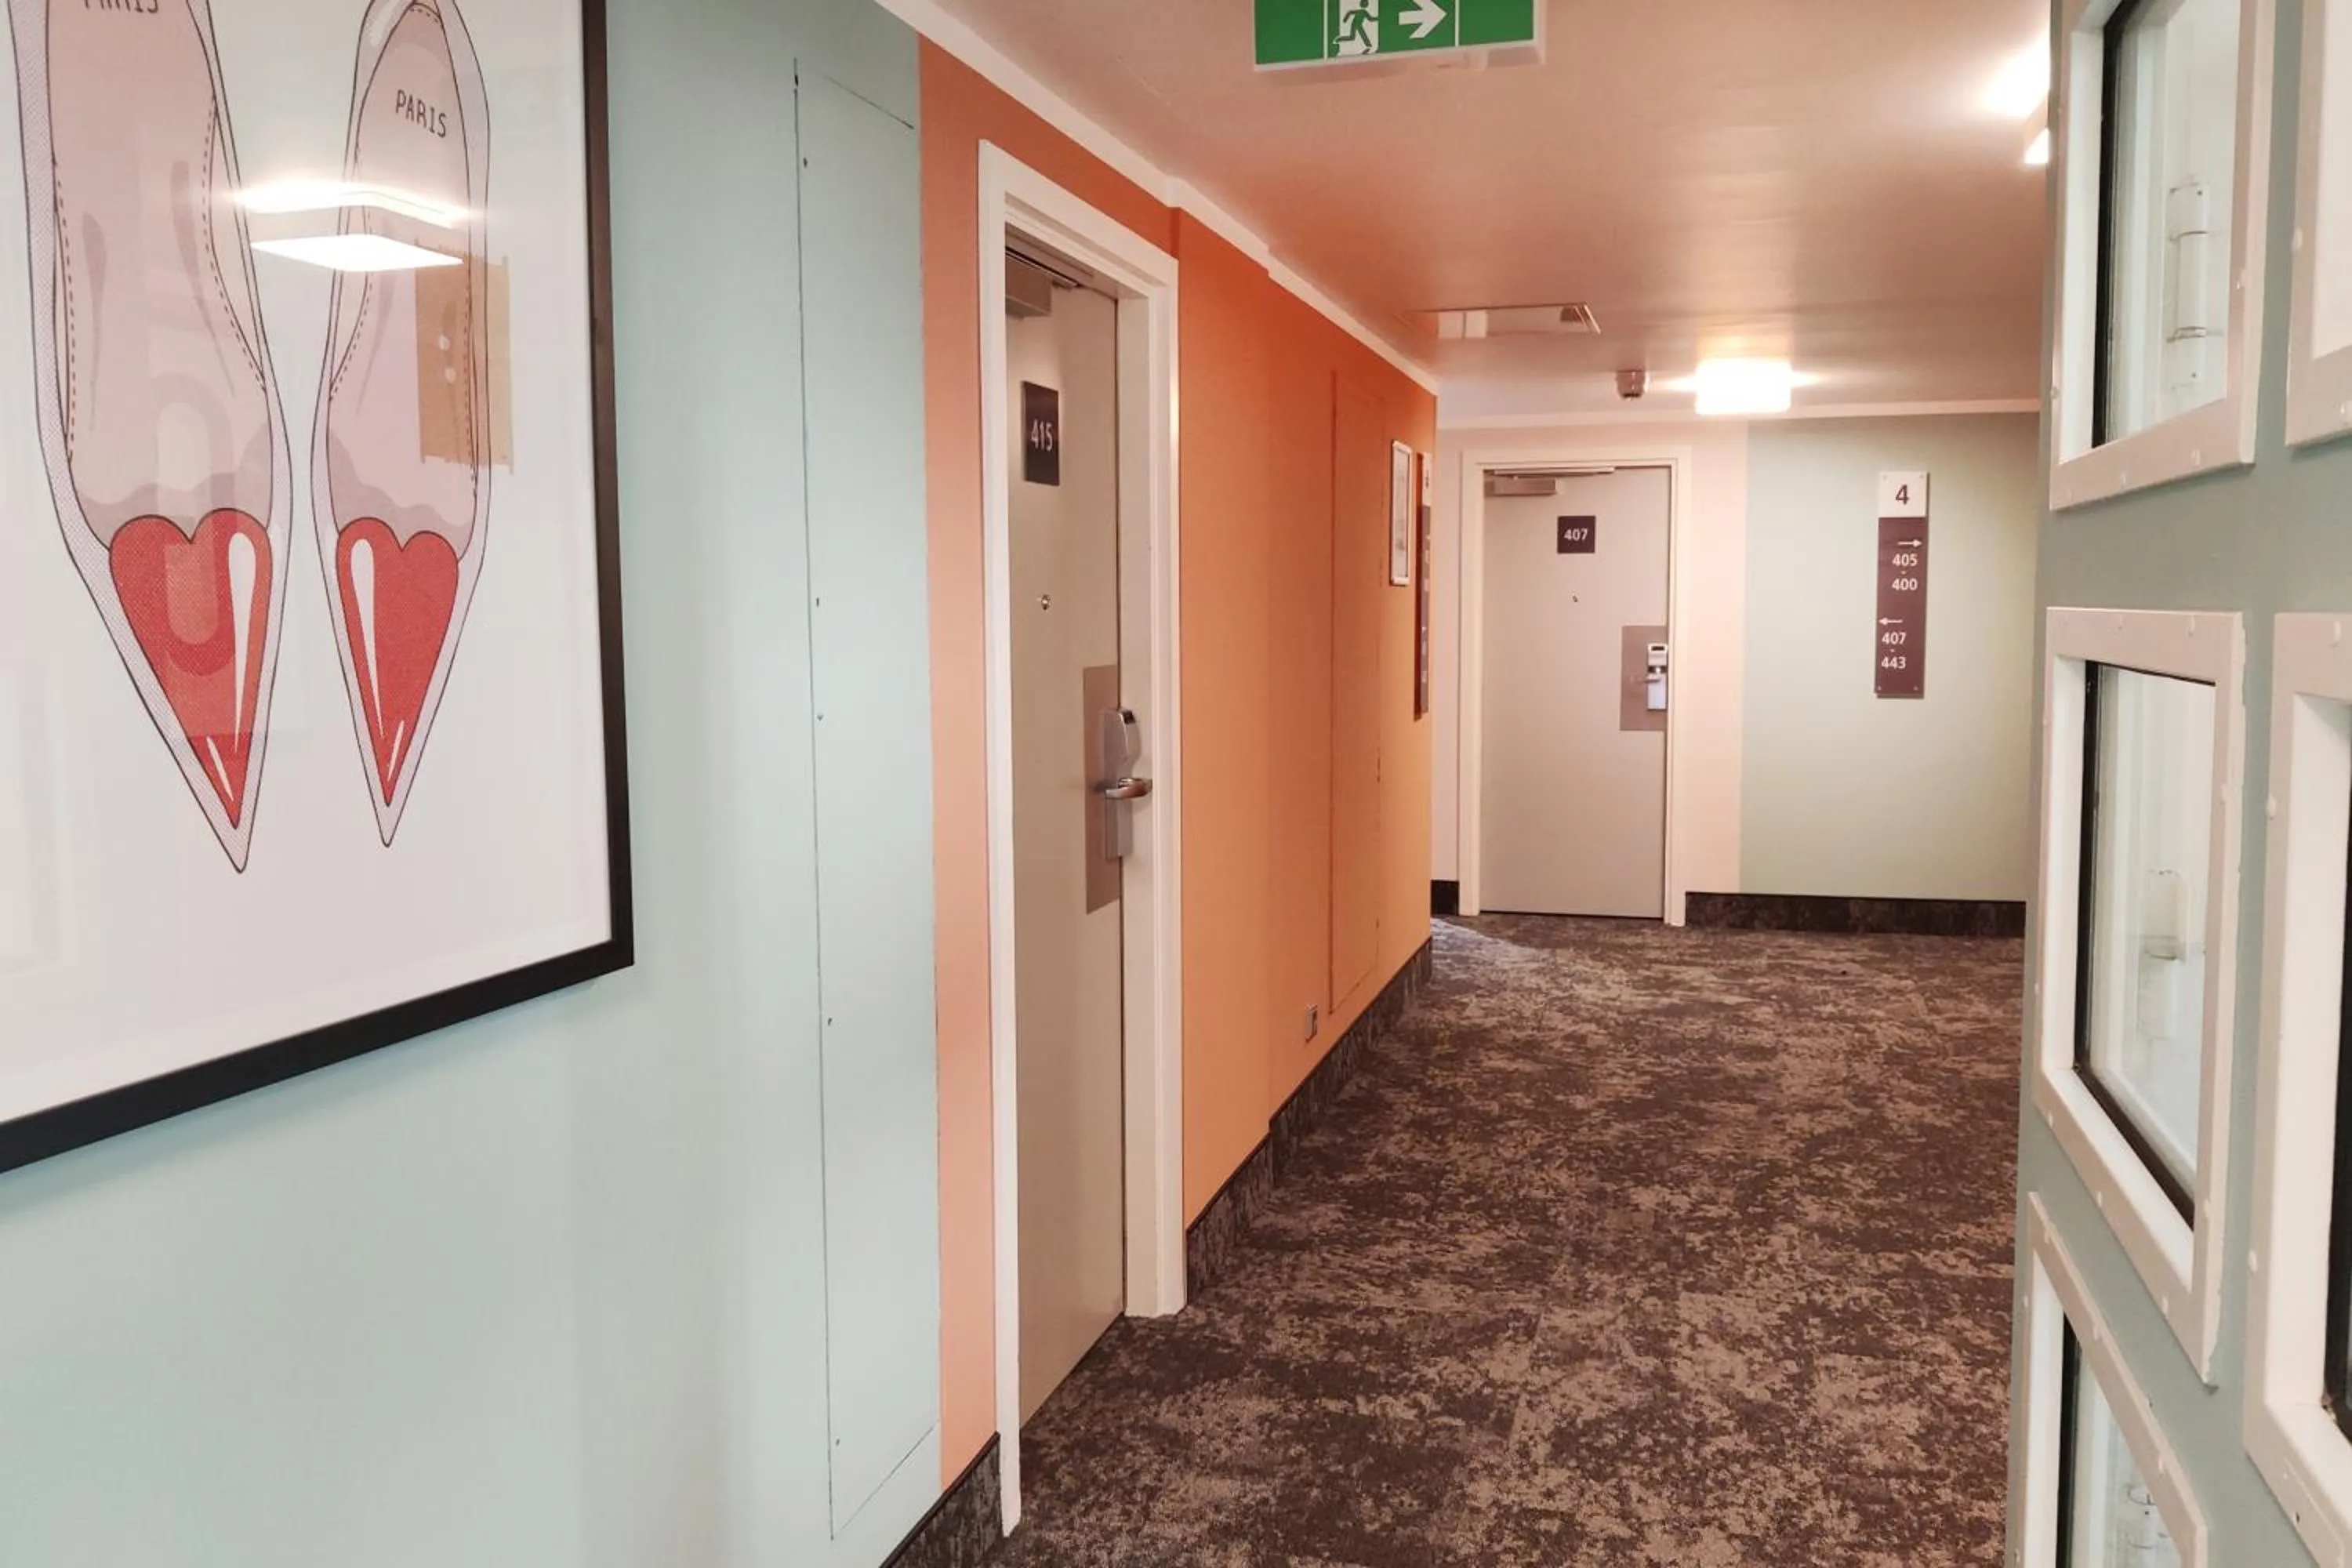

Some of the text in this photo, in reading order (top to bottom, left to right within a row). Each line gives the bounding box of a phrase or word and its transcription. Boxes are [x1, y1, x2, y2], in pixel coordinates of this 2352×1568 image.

[395, 89, 447, 139] PARIS
[1031, 418, 1053, 452] 415
[1895, 484, 1910, 505] 4
[1564, 528, 1588, 541] 407
[1892, 553, 1918, 567] 405
[1892, 578, 1918, 591] 400
[1882, 631, 1907, 645] 407
[1881, 656, 1906, 669] 443
